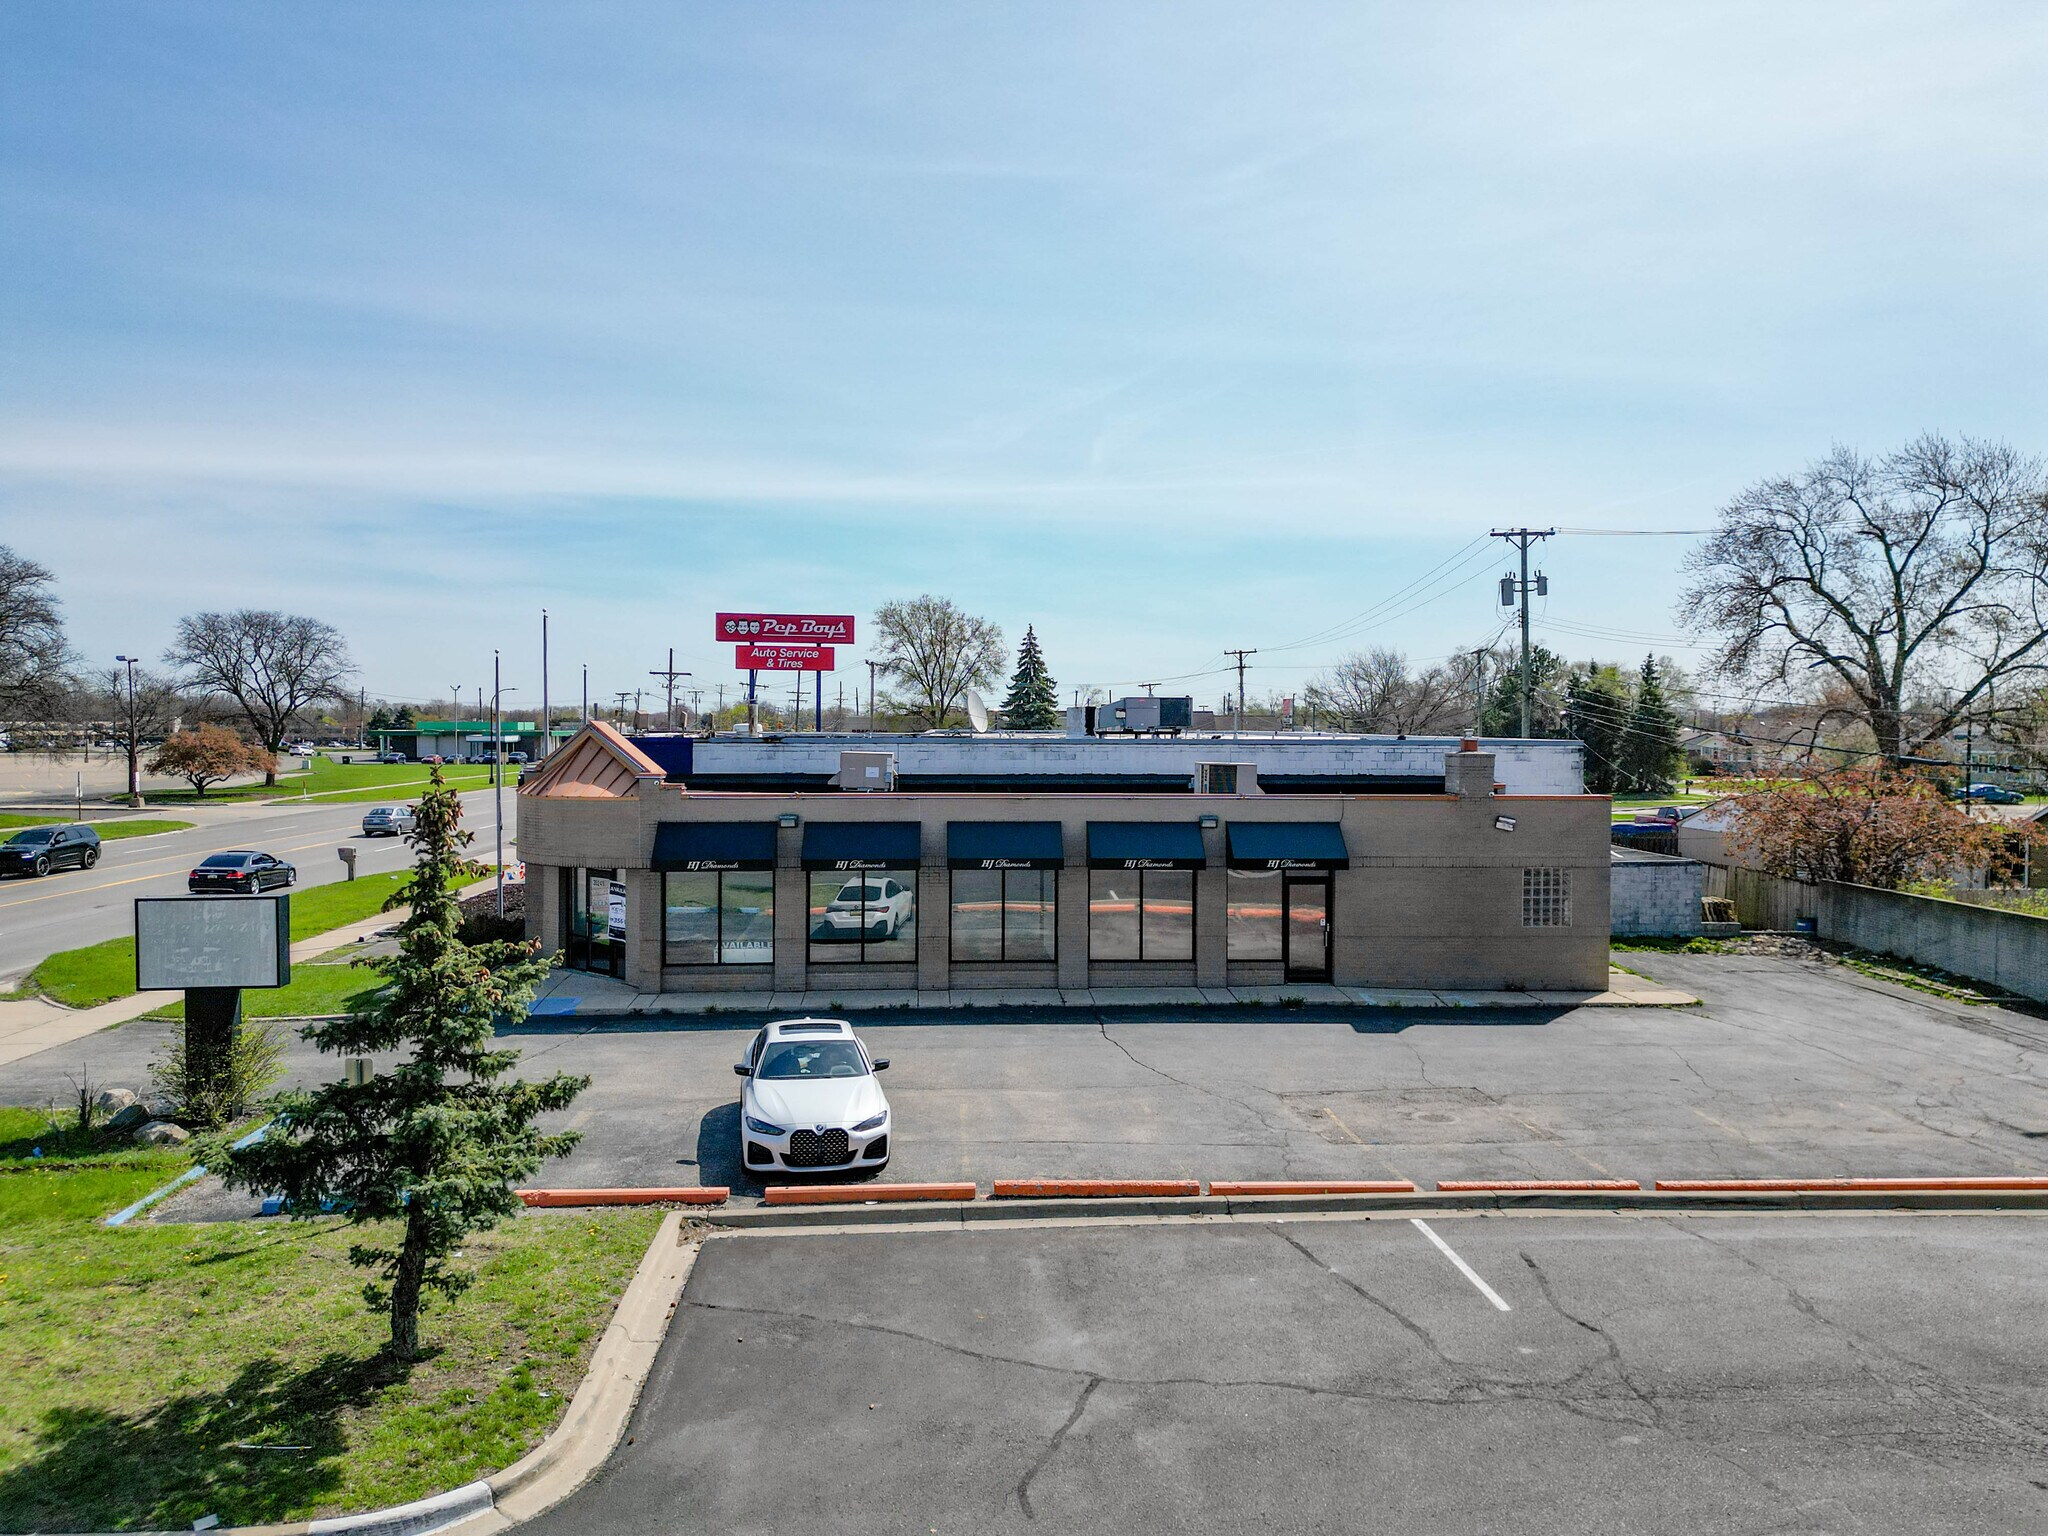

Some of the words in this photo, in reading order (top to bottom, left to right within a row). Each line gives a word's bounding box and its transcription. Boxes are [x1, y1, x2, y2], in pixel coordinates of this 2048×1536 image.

[762, 619, 798, 637] Pep
[800, 619, 847, 639] Boys
[751, 648, 777, 657] Auto
[779, 648, 819, 659] Service
[766, 659, 775, 668] &
[777, 659, 804, 669] Tires
[701, 860, 739, 869] Diamonds
[849, 859, 887, 869] Diamonds
[995, 858, 1031, 868] Diamonds
[1137, 858, 1174, 868] Diamonds
[1281, 858, 1317, 868] Diamonds
